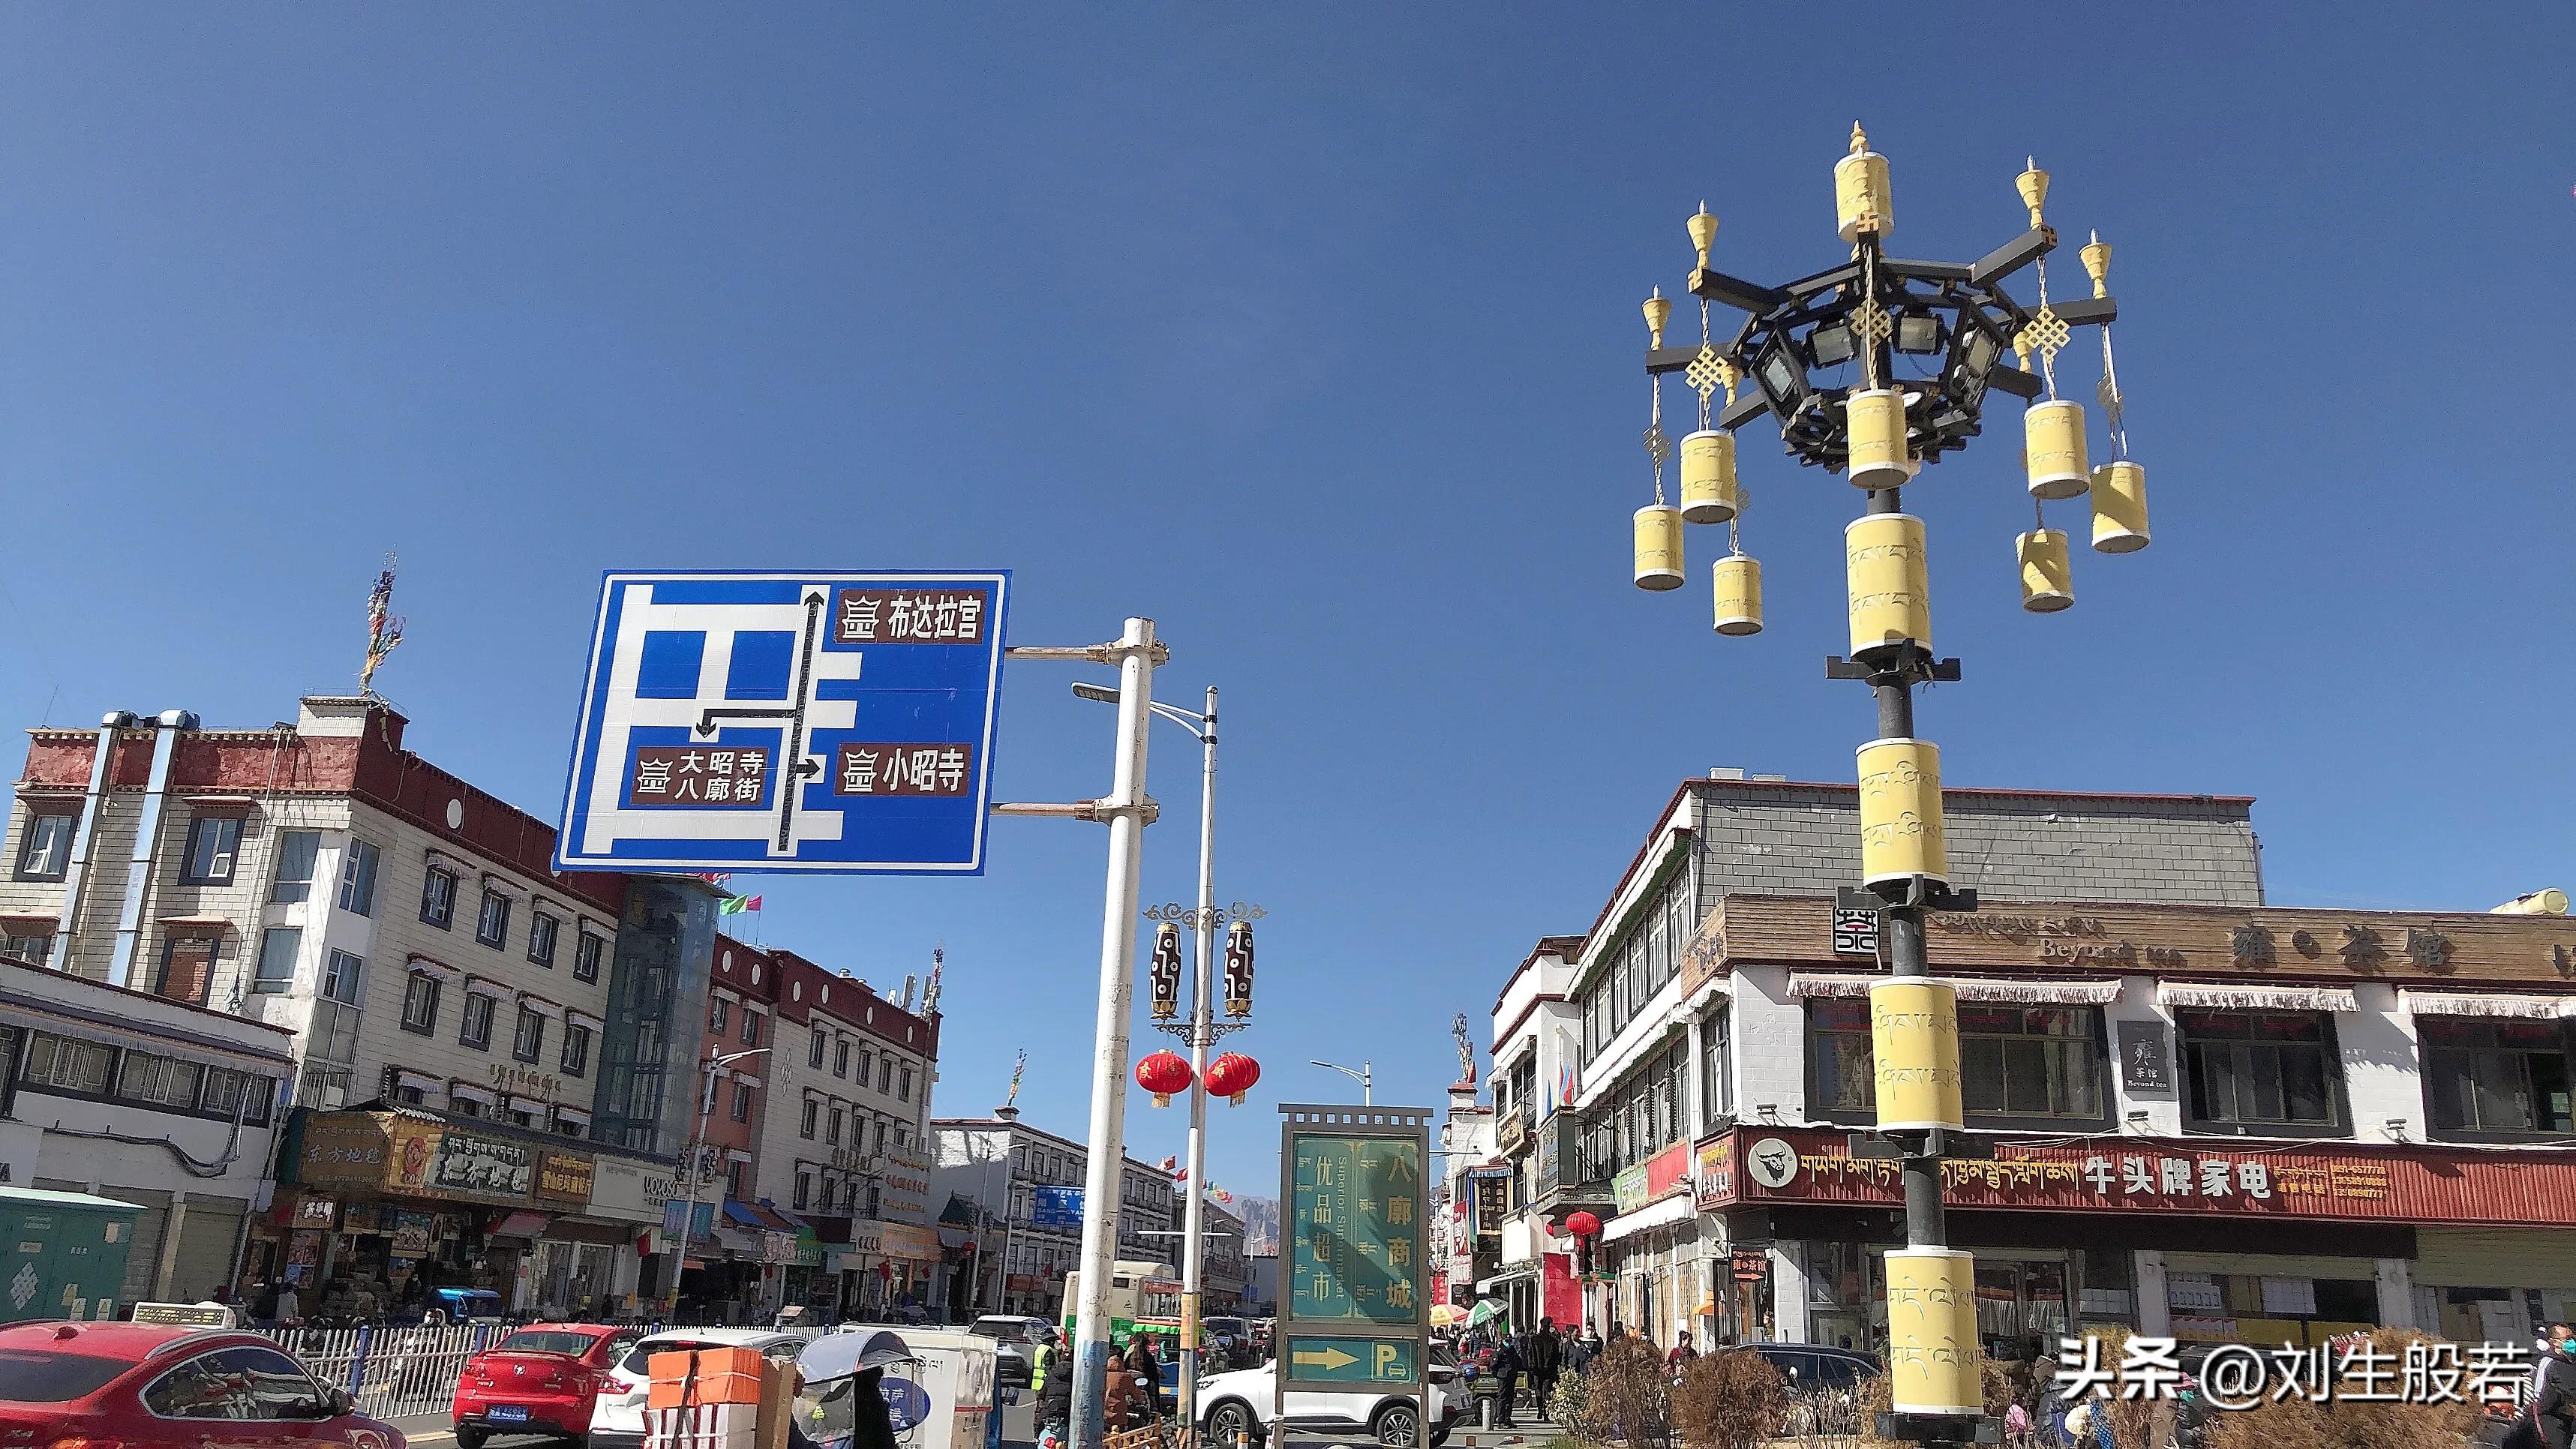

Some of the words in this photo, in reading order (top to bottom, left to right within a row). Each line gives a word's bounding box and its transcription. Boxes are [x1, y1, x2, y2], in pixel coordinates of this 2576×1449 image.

[888, 594, 983, 640] 布达拉宫
[679, 750, 765, 775] 大昭寺
[881, 747, 965, 792] 小昭寺
[674, 776, 761, 802] 八廓街
[2039, 938, 2127, 964] Beyond
[308, 1143, 381, 1164] 东方地毯
[1337, 1156, 1347, 1210] Superior
[2085, 1155, 2271, 1199] 牛头牌家电
[1314, 1156, 1334, 1302] 优品超市
[1386, 1155, 1413, 1310] 八廓商城
[1335, 1215, 1347, 1300] Supermarket
[1377, 1344, 1397, 1377] P
